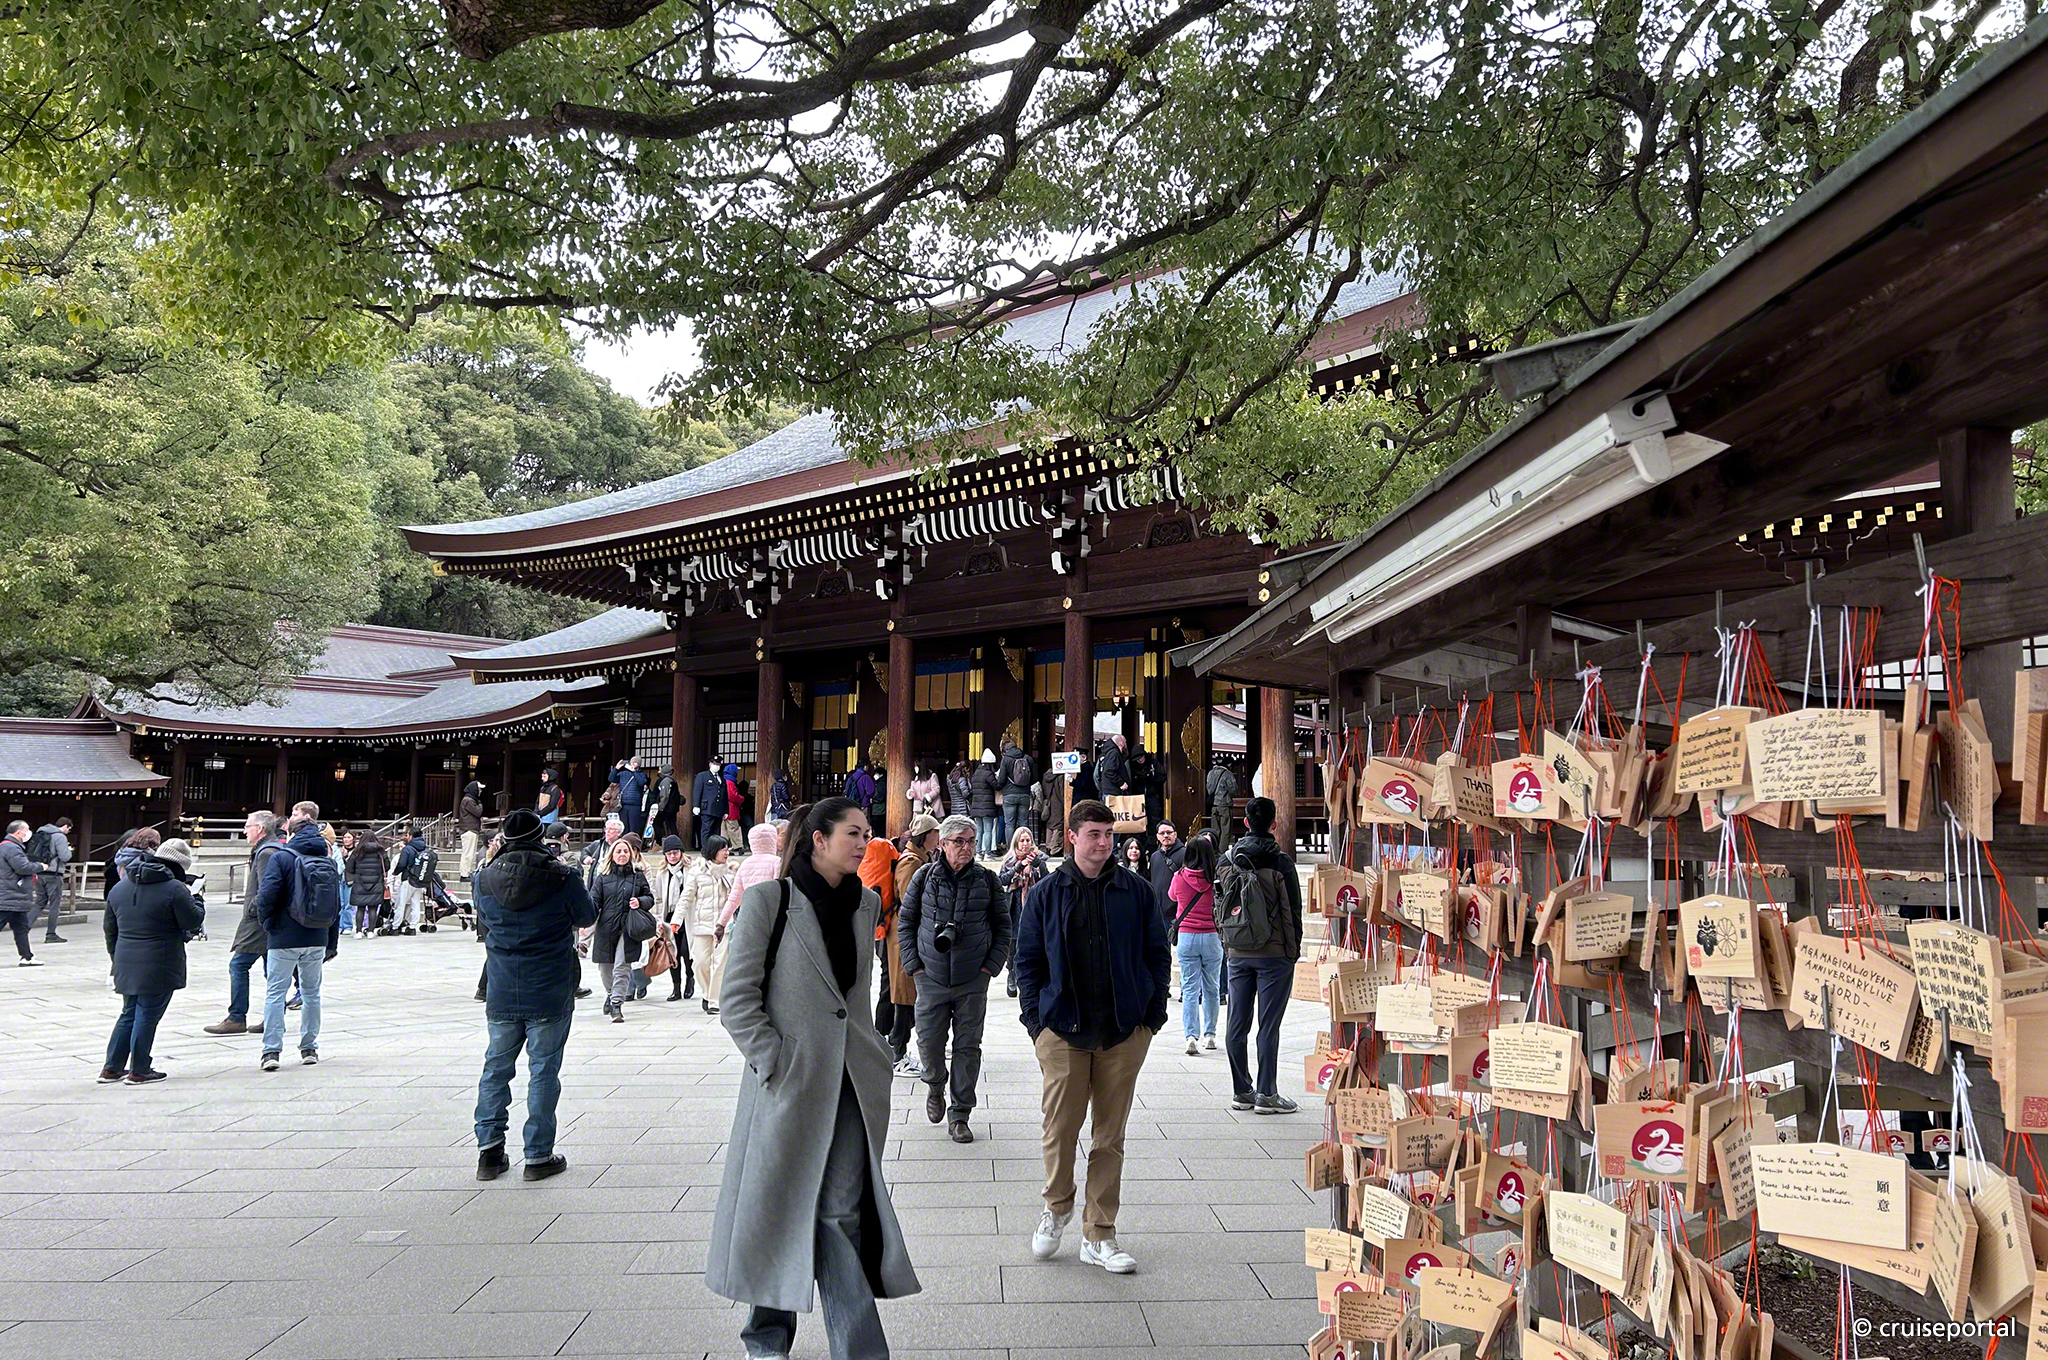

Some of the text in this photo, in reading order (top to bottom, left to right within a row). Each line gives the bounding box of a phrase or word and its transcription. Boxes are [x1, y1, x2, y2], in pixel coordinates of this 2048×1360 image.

[1114, 812, 1130, 821] IKE
[1801, 945, 1818, 959] MGA
[1820, 953, 1860, 975] MAGICAL
[1870, 970, 1899, 992] YEARS
[1805, 960, 1870, 992] ANNIVERSARY
